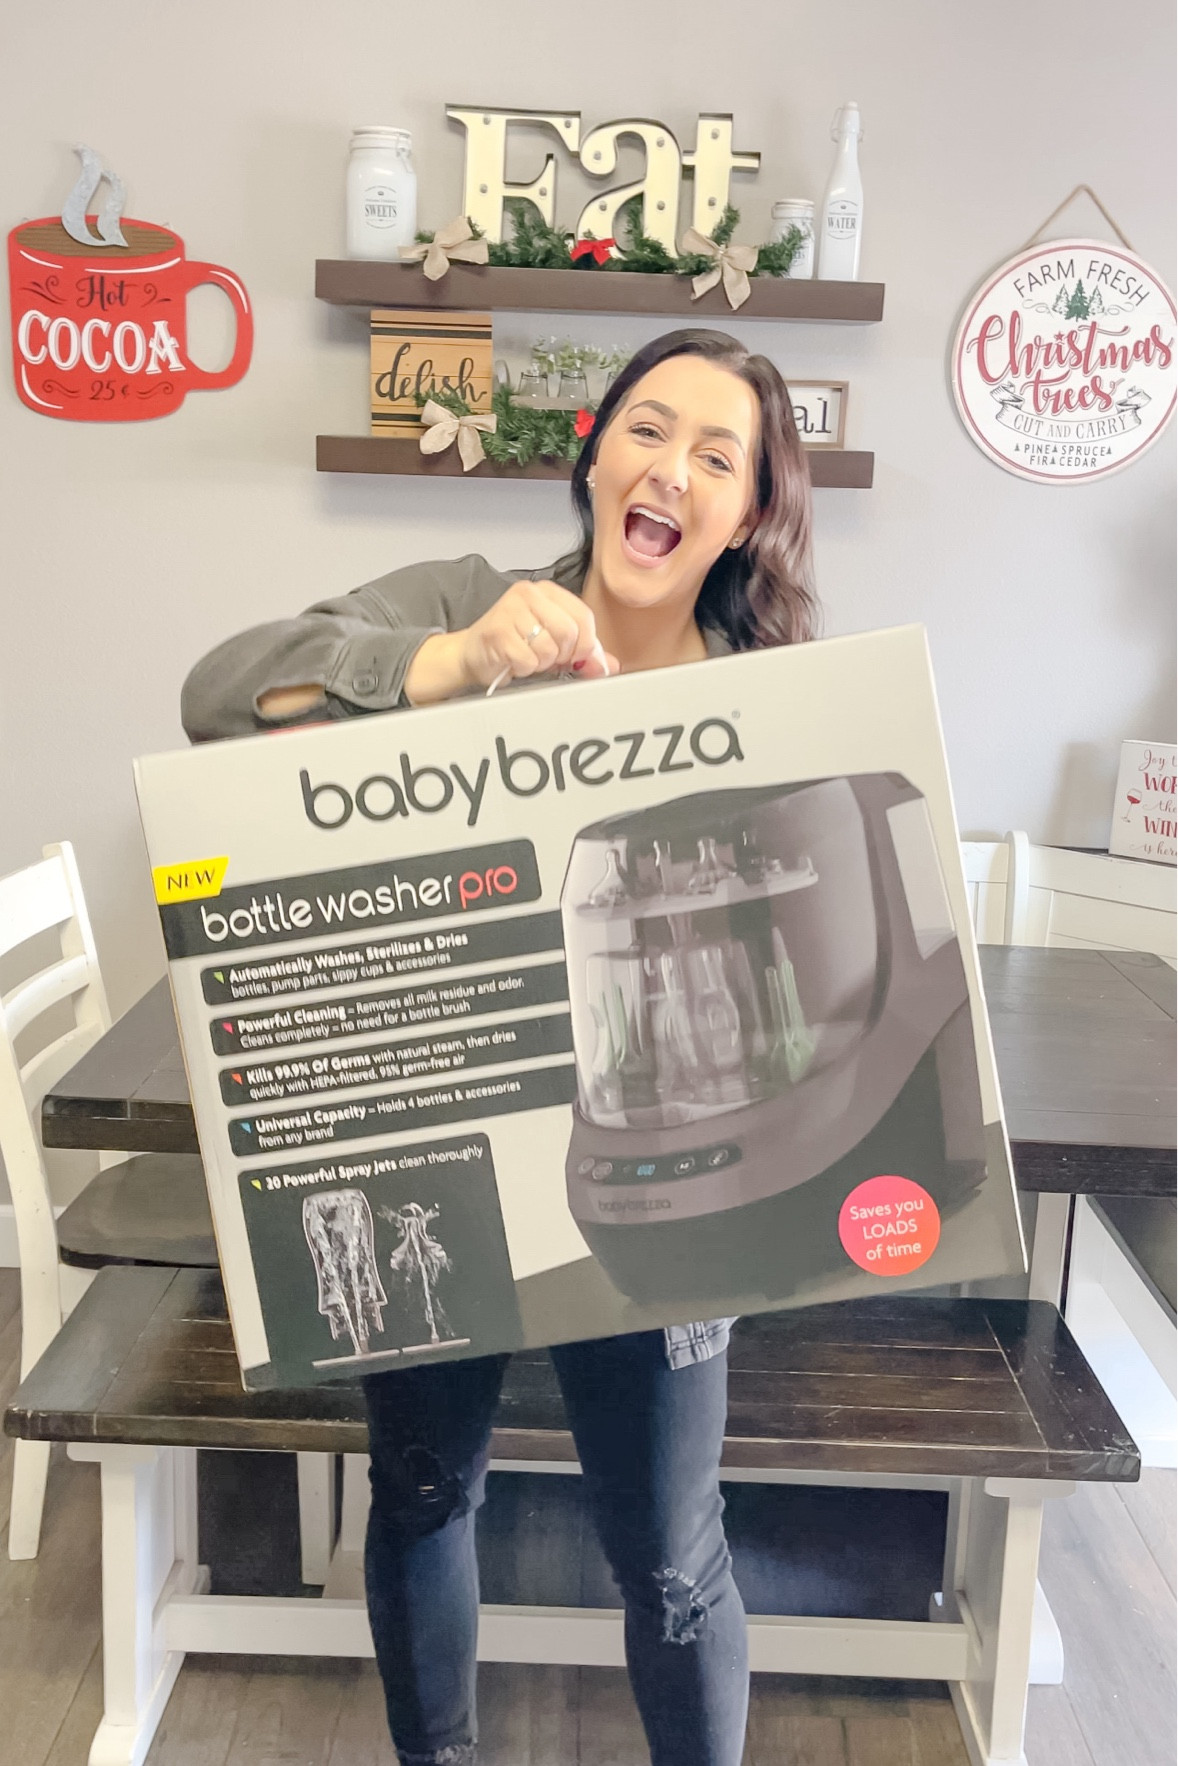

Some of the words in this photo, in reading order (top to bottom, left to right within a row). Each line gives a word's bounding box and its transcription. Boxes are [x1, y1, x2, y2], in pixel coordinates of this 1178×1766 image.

[444, 103, 761, 260] Eat
[364, 204, 397, 218] SWEETS
[827, 216, 857, 230] WATER
[75, 275, 138, 311] Hot
[1013, 258, 1075, 298] FARM
[1087, 260, 1150, 307] FRESH
[18, 309, 187, 375] COCOA
[967, 310, 1174, 383] Christmas
[375, 342, 488, 403] delish
[1020, 369, 1125, 416] trees
[1013, 413, 1044, 436] CUT
[1047, 424, 1071, 438] AND
[1076, 414, 1126, 439] CARRY
[1024, 443, 1051, 454] PINE
[1061, 445, 1106, 457] SPRUCE
[1029, 455, 1048, 466] FIR
[1059, 456, 1097, 467] CEDAR
[1144, 815, 1177, 838] WIN
[167, 866, 216, 891] NEW
[200, 892, 313, 942] bottle
[316, 874, 453, 924] washer
[459, 865, 518, 910] pro
[229, 956, 313, 984] Automatically
[366, 941, 422, 961] Sterilizes
[423, 936, 434, 951] &
[436, 932, 469, 950] Dries
[271, 977, 301, 994] pump
[332, 967, 358, 983] sippy
[360, 964, 384, 978] cups
[385, 960, 394, 973] &
[396, 952, 451, 971] accessories
[237, 1011, 293, 1034] Powerful
[294, 1005, 347, 1024] Cleaning
[356, 998, 401, 1015] Removes
[403, 992, 415, 1007] all
[416, 989, 438, 1004] milk
[439, 985, 476, 1001] residue
[477, 979, 496, 995] and
[240, 1033, 274, 1049] Cleans
[274, 1022, 330, 1043] completely
[340, 1020, 355, 1033] no
[356, 1012, 382, 1030] need
[383, 1011, 399, 1026] for
[401, 1011, 408, 1022] a
[408, 1004, 441, 1021] bottle
[441, 999, 471, 1016] brush
[246, 1066, 274, 1085] Kills
[274, 1062, 311, 1080] 99.9%
[330, 1053, 371, 1071] Germs
[371, 1048, 396, 1064] with
[396, 1042, 431, 1060] natural
[466, 1035, 491, 1049] then
[491, 1030, 517, 1045] dries
[249, 1083, 285, 1101] quickly
[285, 1077, 310, 1094] with
[402, 1056, 451, 1077] germ-free
[452, 1053, 466, 1066] air
[255, 1111, 313, 1134] Universal
[313, 1105, 367, 1125] Capacity
[376, 1098, 407, 1114] Holds
[408, 1096, 415, 1109] 4
[416, 1091, 453, 1108] bottles
[455, 1089, 464, 1102] &
[465, 1080, 522, 1100] accessories
[258, 1134, 285, 1148] from
[285, 1131, 303, 1145] any
[304, 1124, 334, 1141] brand
[265, 1175, 282, 1191] 20
[282, 1166, 337, 1188] Powerful
[338, 1163, 372, 1181] Spray
[373, 1159, 397, 1176] Jets
[398, 1155, 427, 1169] clean
[427, 1144, 483, 1164] thoroughly
[849, 1204, 892, 1220] Saves
[894, 1199, 924, 1218] you
[862, 1218, 918, 1240] LOADS
[866, 1243, 883, 1261] of
[886, 1242, 922, 1258] time
